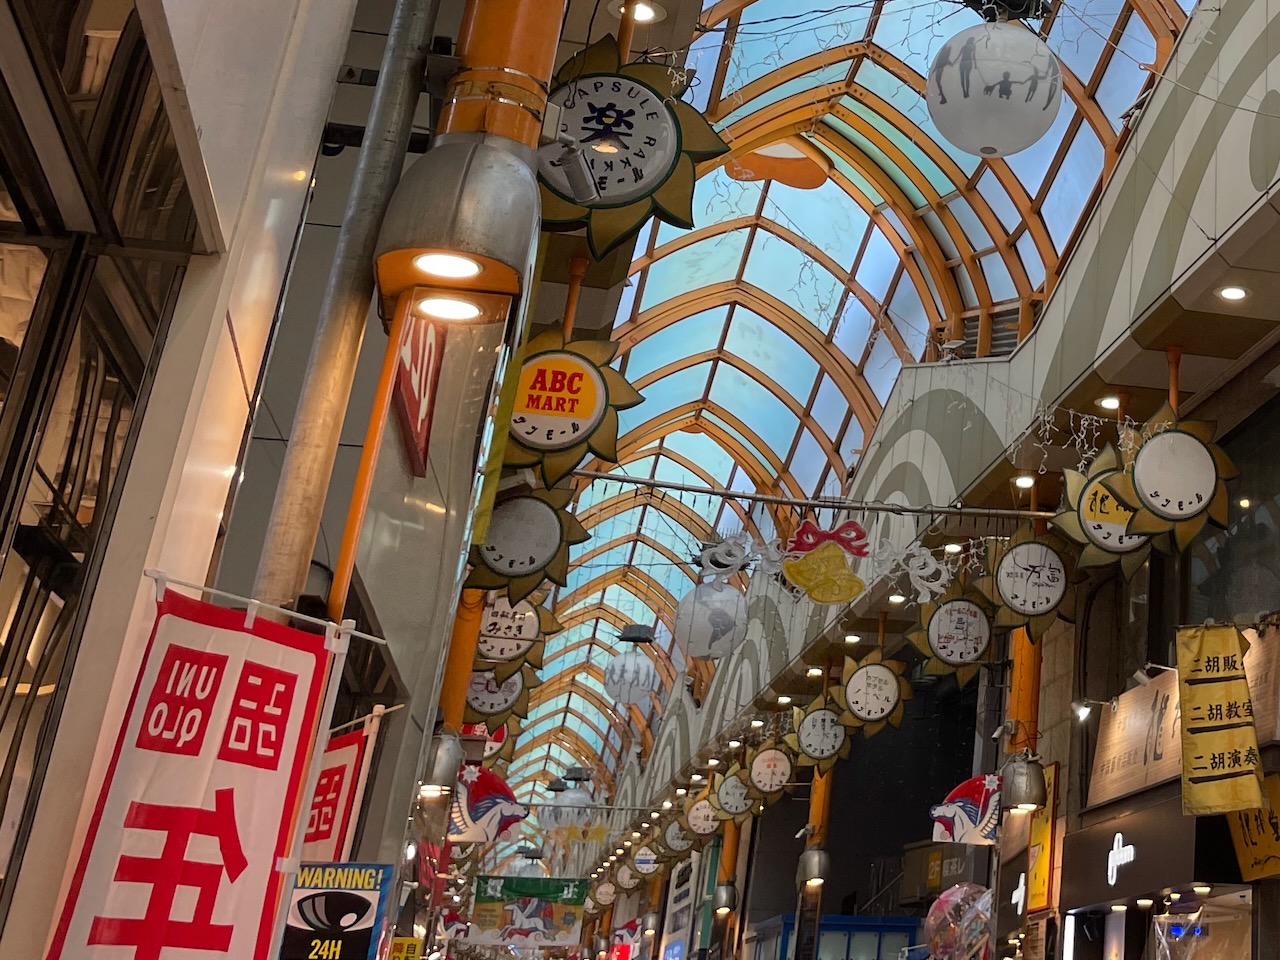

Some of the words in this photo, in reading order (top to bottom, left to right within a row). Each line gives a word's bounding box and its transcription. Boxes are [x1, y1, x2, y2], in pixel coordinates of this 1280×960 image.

[529, 368, 583, 394] ABC
[525, 394, 579, 413] MART
[513, 415, 580, 440] サンモール
[1150, 490, 1203, 511] サンモール
[1191, 654, 1246, 674] 二胡販
[1191, 699, 1254, 721] 二胡教室
[1192, 747, 1259, 771] 二胡演奏
[296, 867, 384, 889] WARNING!
[308, 939, 343, 960] 24H
